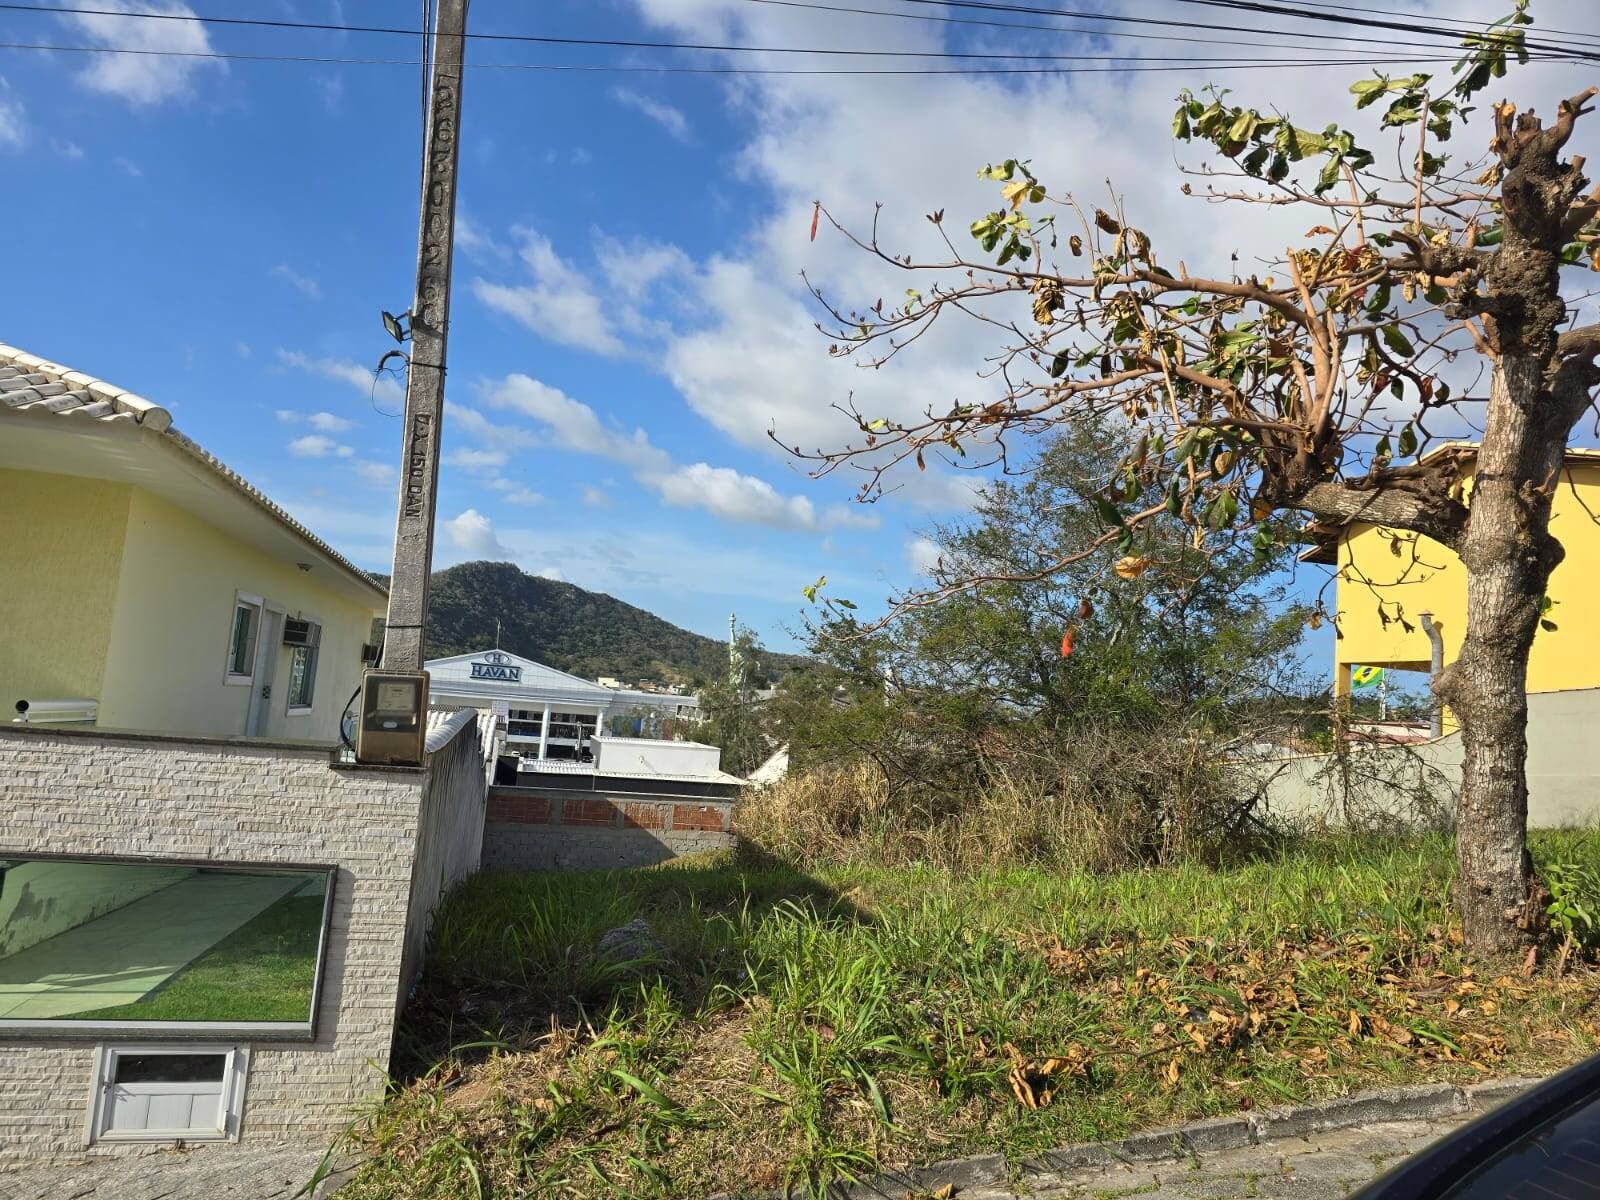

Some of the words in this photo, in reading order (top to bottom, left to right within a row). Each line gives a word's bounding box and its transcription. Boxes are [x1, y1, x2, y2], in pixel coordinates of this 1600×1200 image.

[411, 453, 426, 478] 150
[405, 485, 423, 518] DAN
[471, 666, 519, 680] HAVAN
